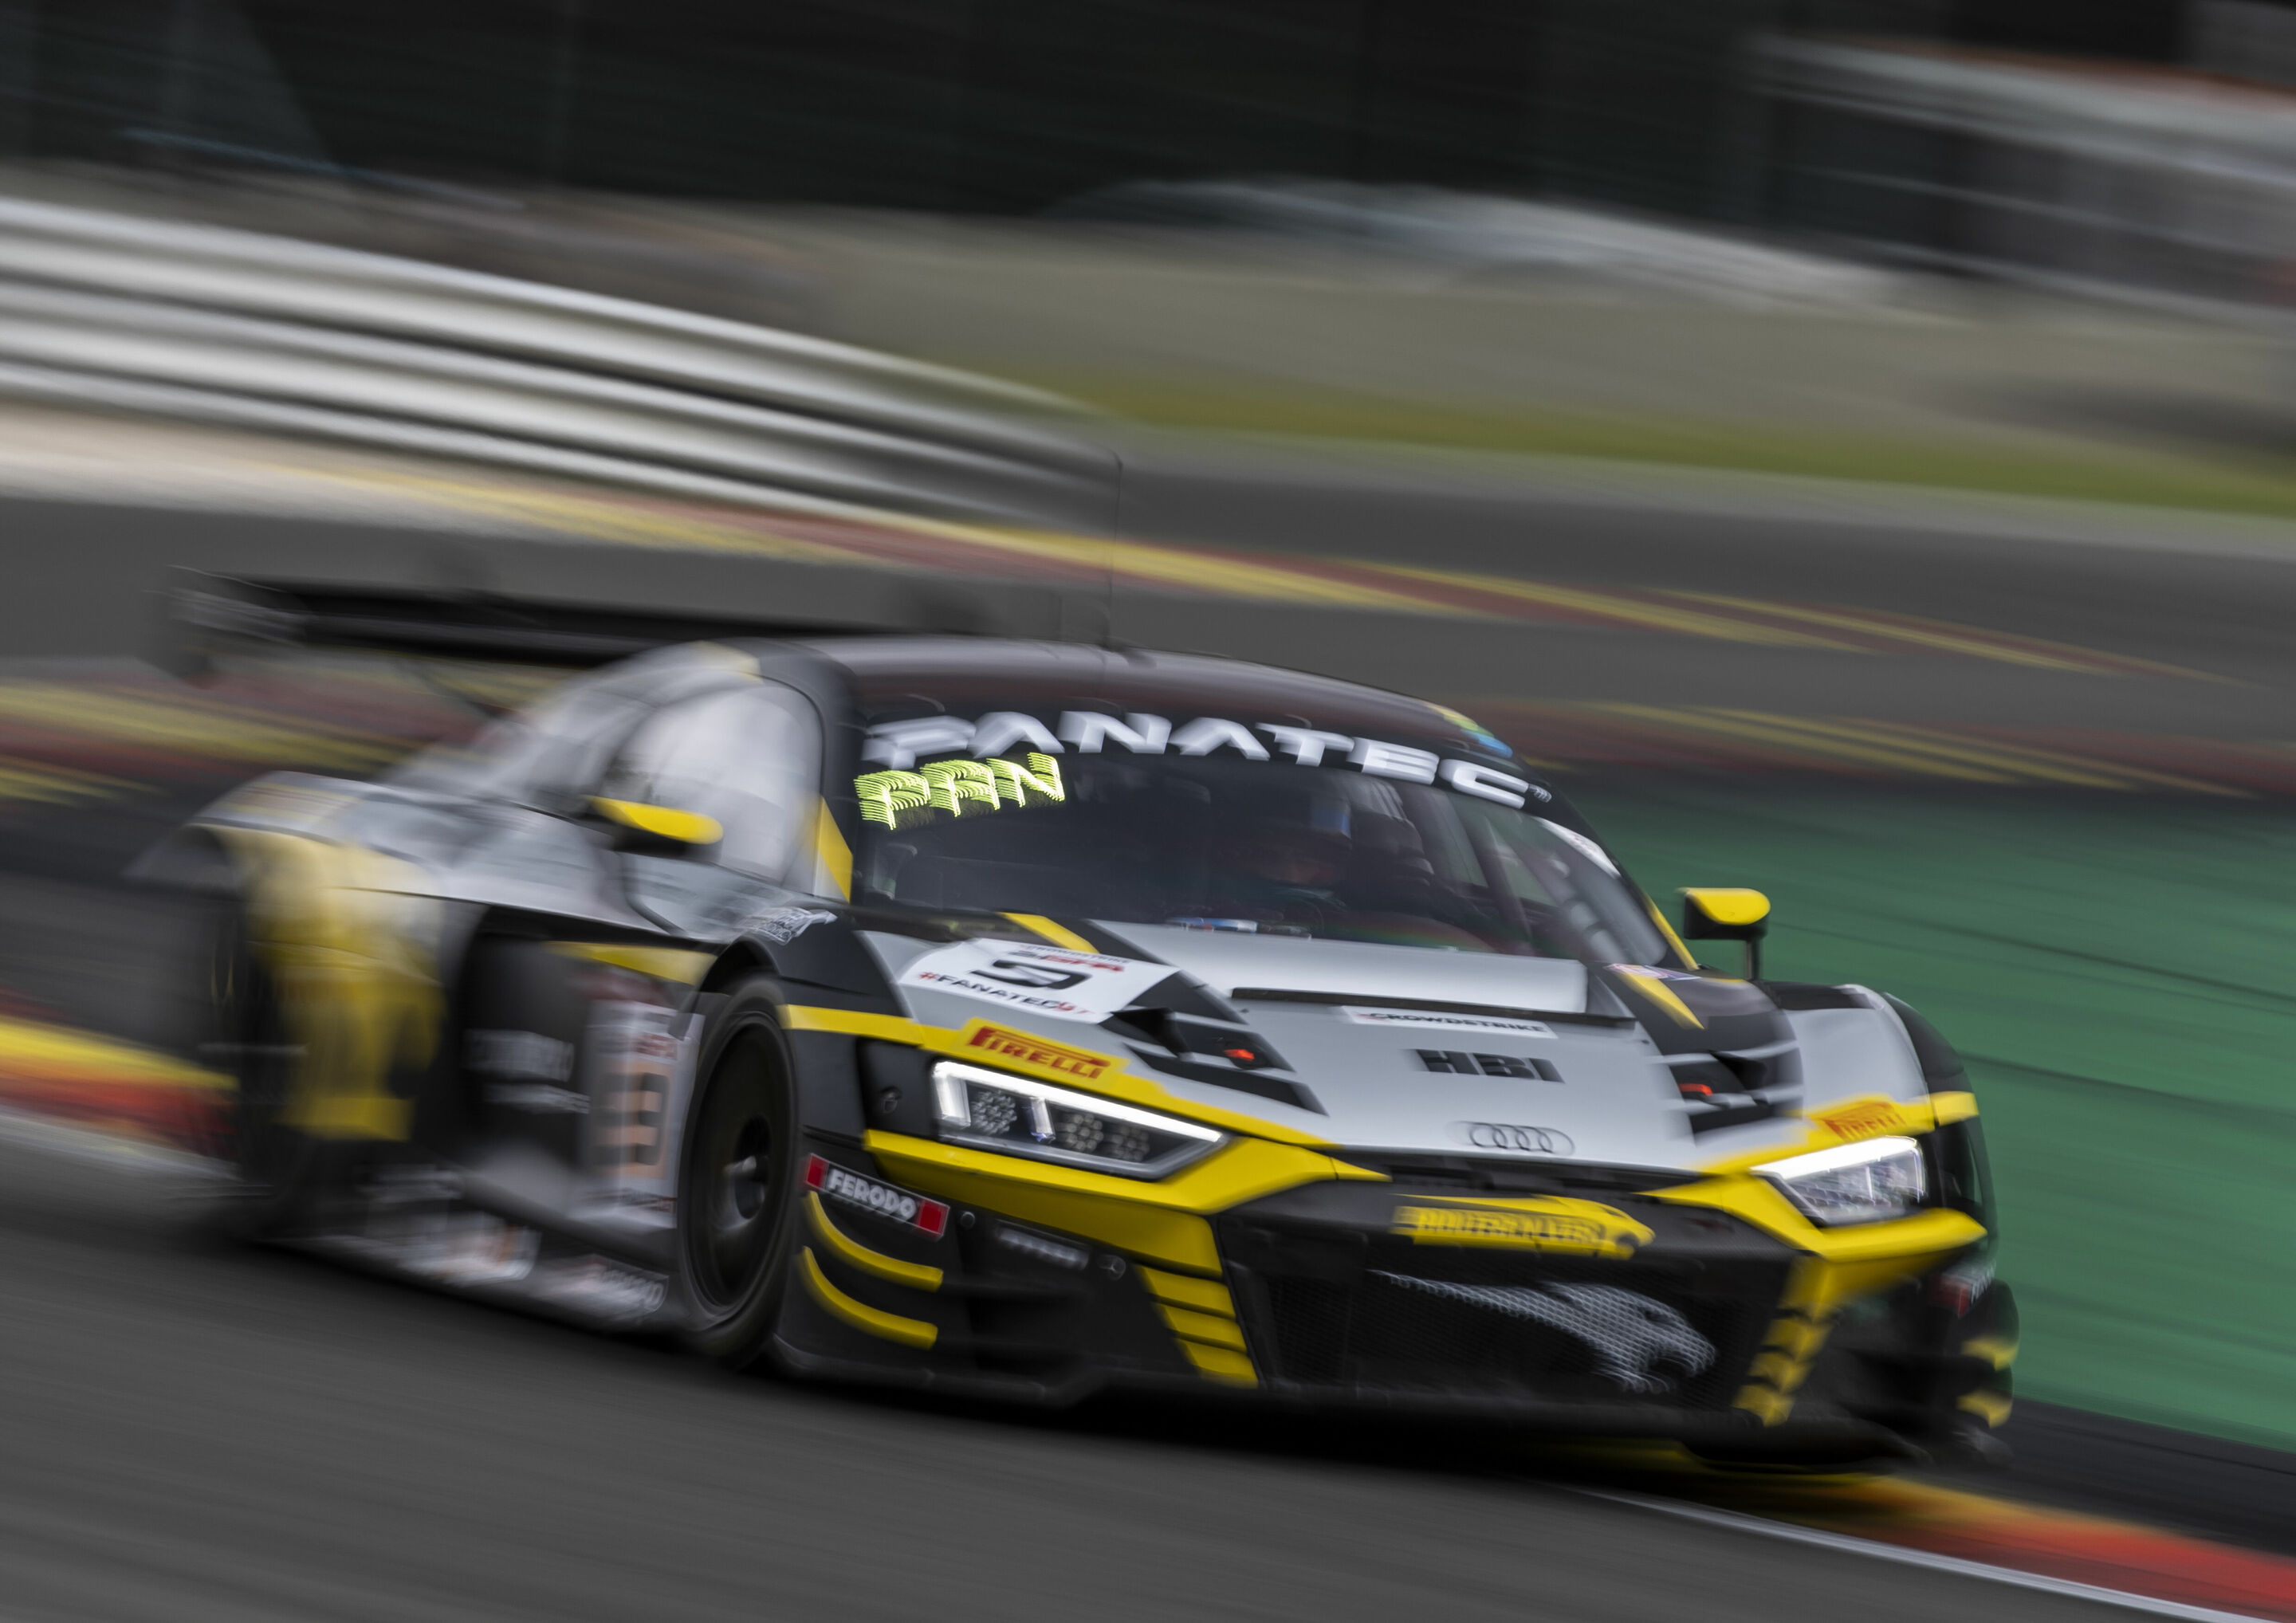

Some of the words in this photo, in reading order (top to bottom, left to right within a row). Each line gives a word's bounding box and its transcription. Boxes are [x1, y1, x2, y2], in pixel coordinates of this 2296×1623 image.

[861, 709, 1528, 808] FANATEC
[1369, 1012, 1549, 1032] CROWDSTRIKE
[967, 1025, 1111, 1079] PIRELLI
[828, 1168, 918, 1221] FERODO
